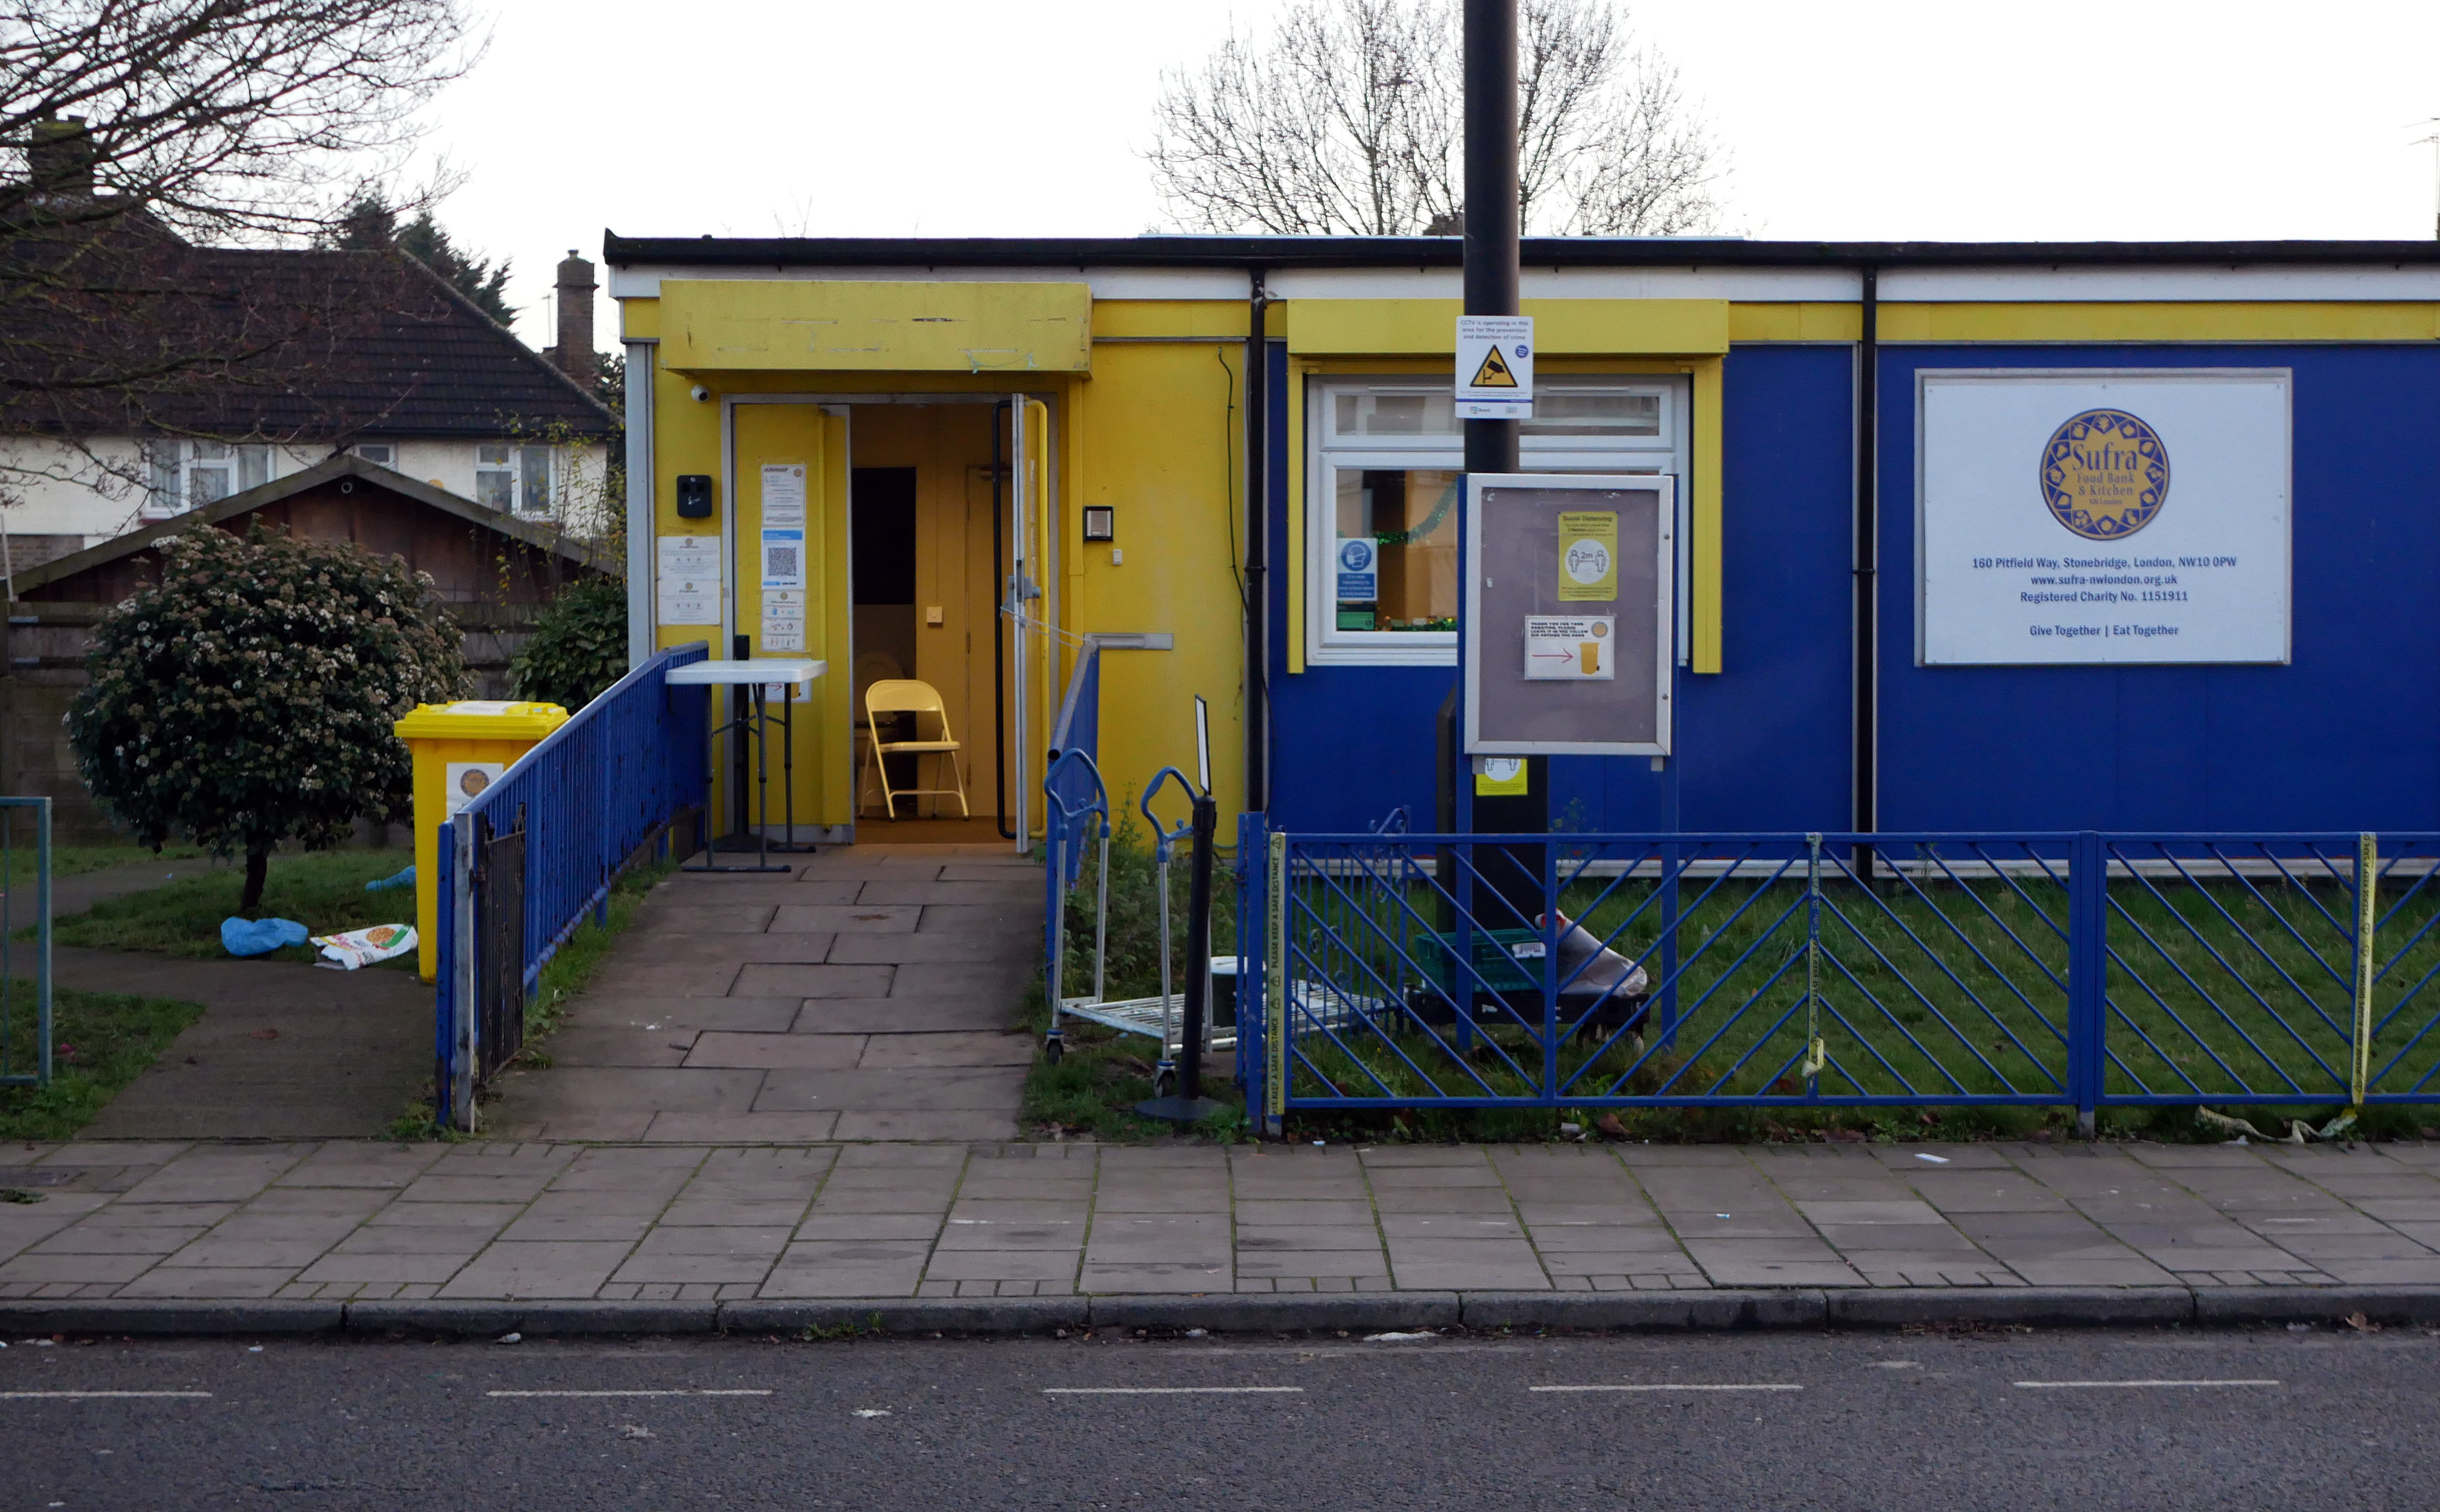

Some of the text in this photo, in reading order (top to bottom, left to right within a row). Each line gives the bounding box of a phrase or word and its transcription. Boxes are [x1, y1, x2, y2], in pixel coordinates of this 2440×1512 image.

[2072, 441, 2137, 470] Sufra
[2078, 472, 2134, 483] Food Bank
[2078, 483, 2134, 495] & Kitchen
[1973, 557, 2237, 570] 160 Pitfield Way, Stonebridge, London, NW10 0PW
[2030, 574, 2178, 586] www.sufra-nwlondon.org.uk
[2020, 591, 2188, 603] Registered Charity No. 1151911
[2030, 625, 2052, 635] Give
[2055, 625, 2101, 637] Together
[2113, 625, 2130, 635] Eat
[2133, 625, 2179, 637] Together
